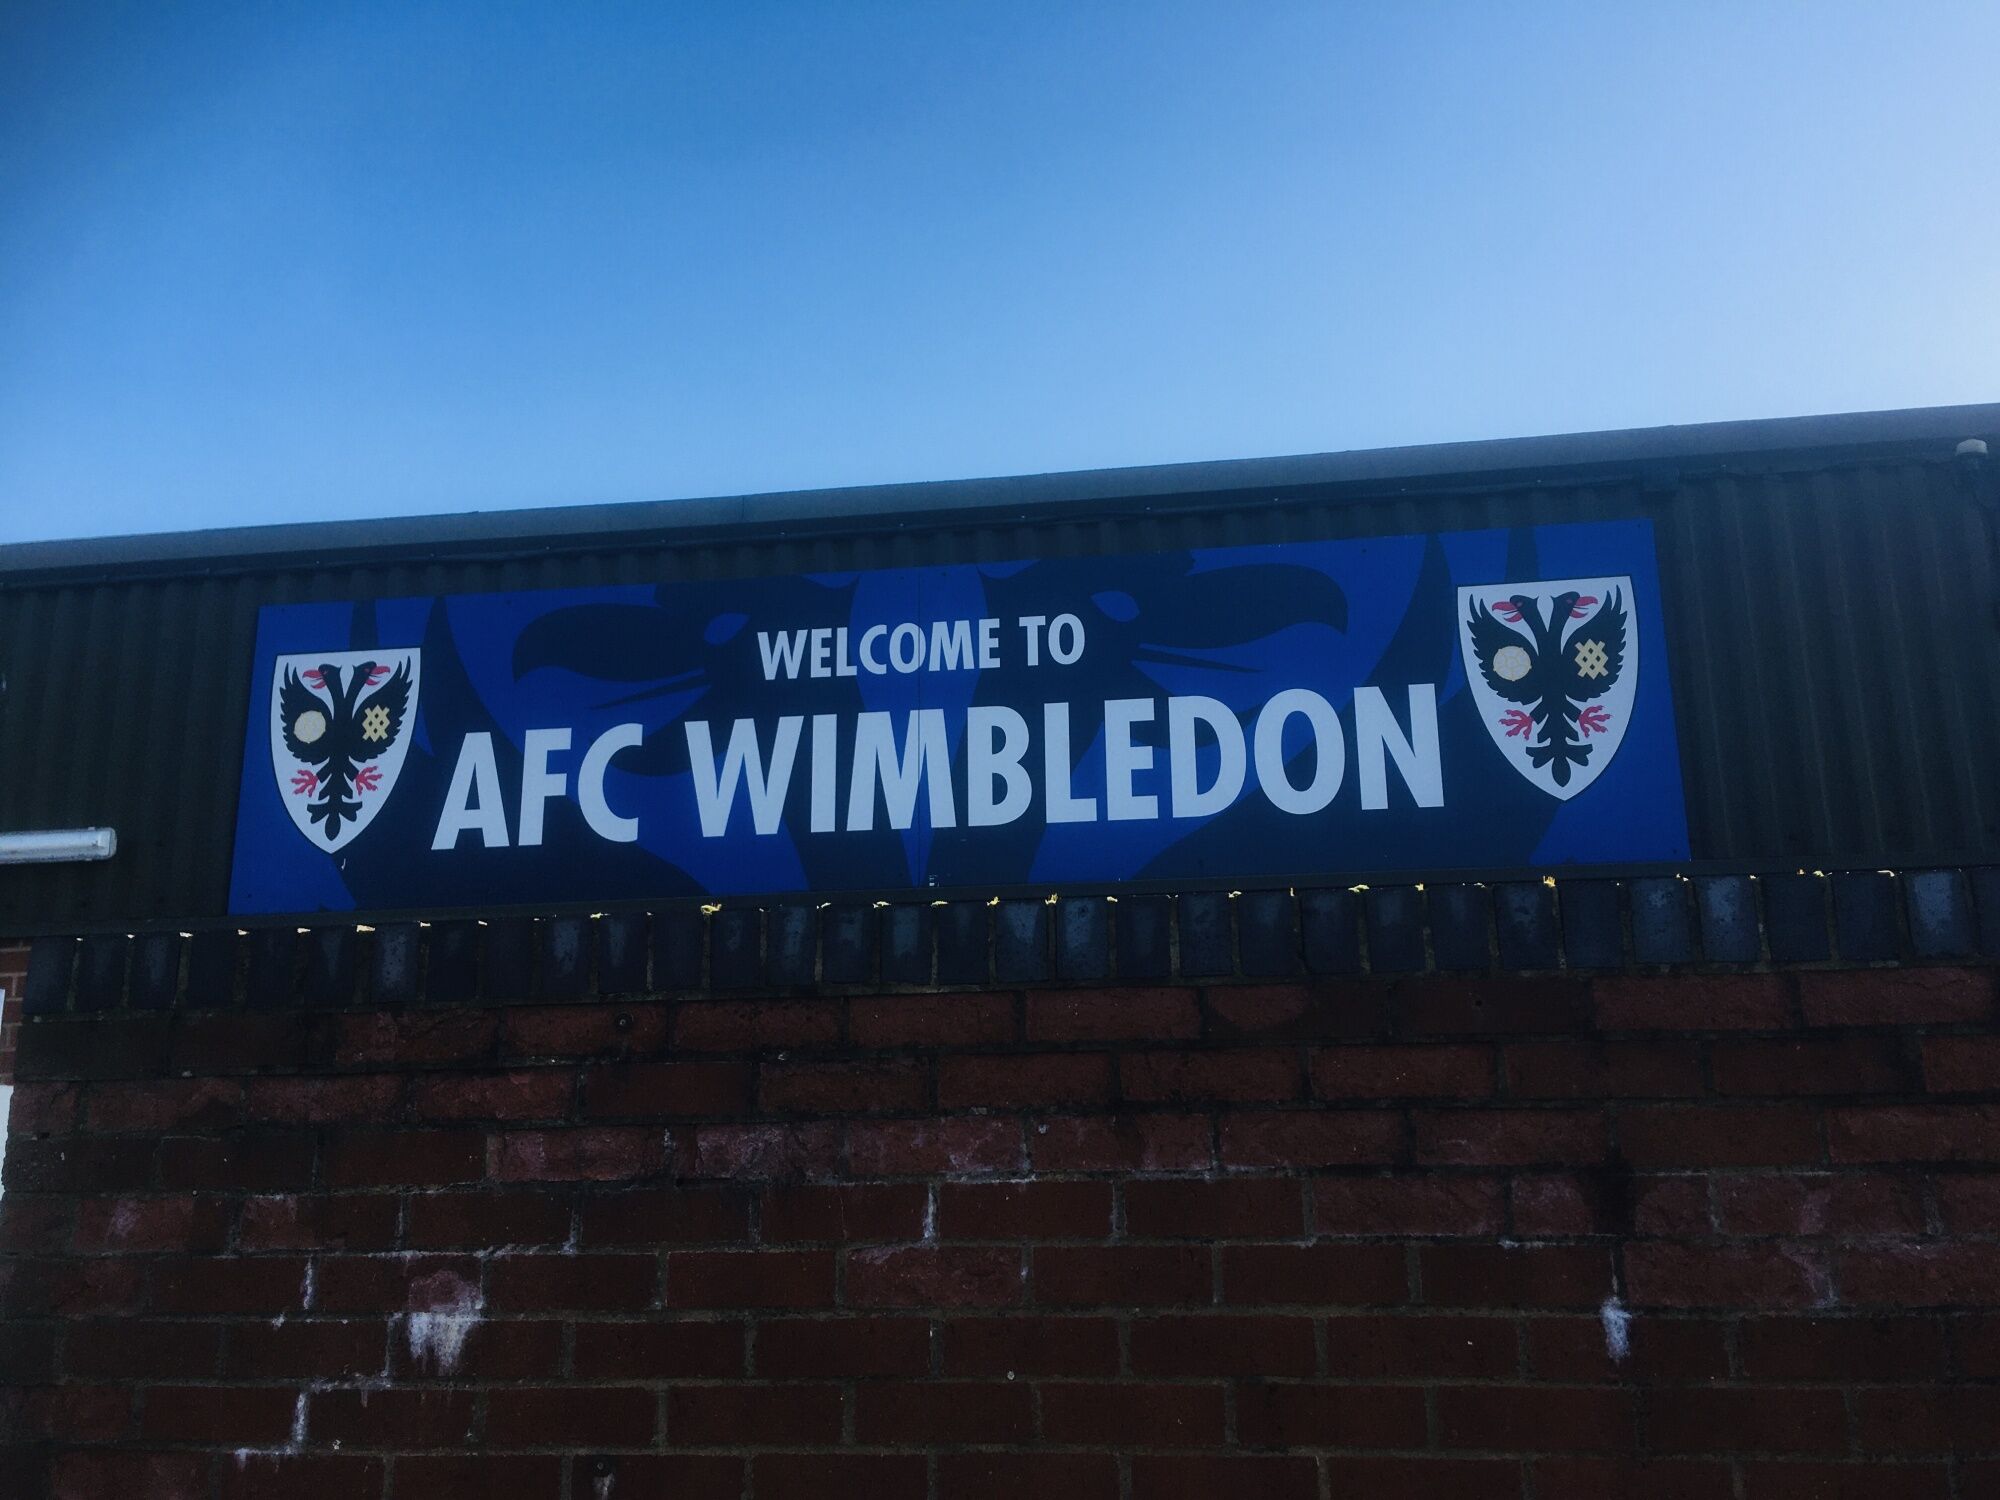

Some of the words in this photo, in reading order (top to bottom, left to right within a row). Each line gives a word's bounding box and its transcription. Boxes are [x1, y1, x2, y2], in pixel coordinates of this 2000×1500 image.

[757, 618, 1001, 681] WELCOME
[1018, 613, 1086, 667] TO
[431, 723, 643, 850] AFC
[684, 683, 1444, 838] WIMBLEDON
